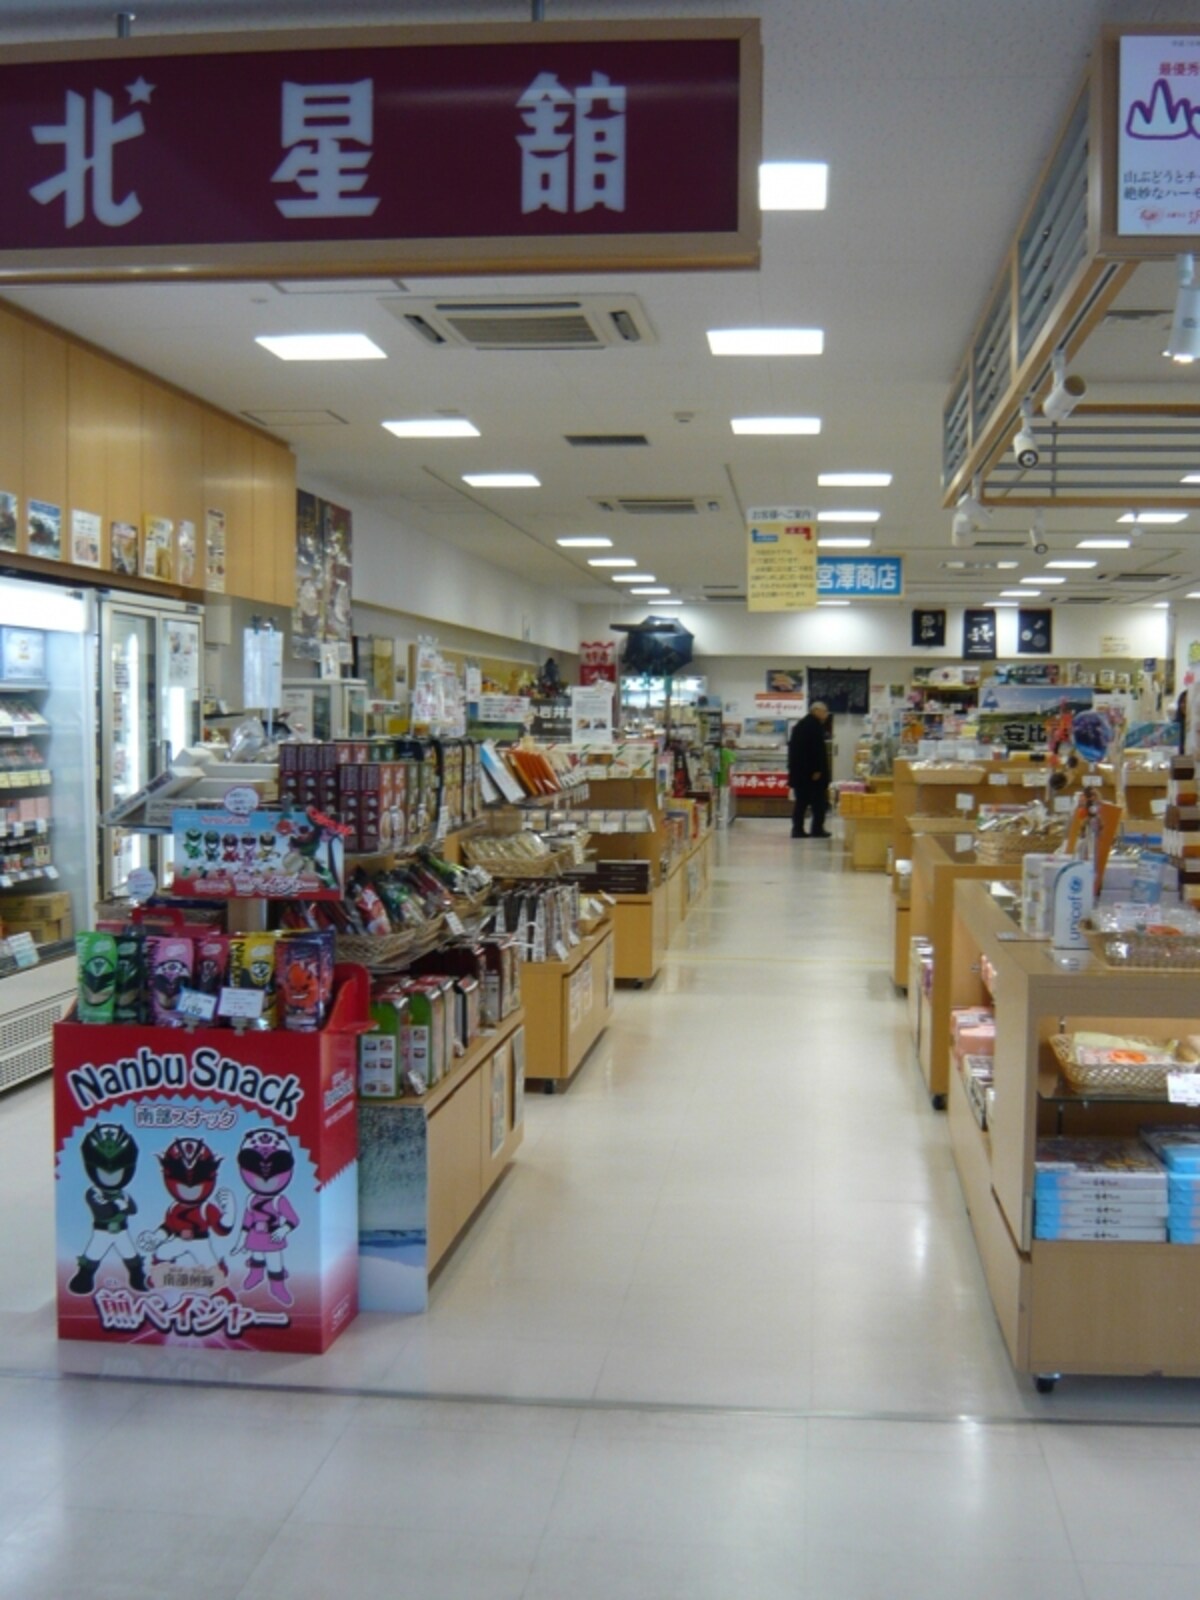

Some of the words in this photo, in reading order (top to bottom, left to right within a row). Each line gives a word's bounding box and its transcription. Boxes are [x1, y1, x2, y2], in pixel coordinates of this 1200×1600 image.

[1124, 169, 1200, 185] 山ぶどうとチ
[69, 1047, 185, 1108] Nanbu
[191, 1047, 304, 1121] Snack
[135, 1104, 238, 1130] 南部スナック
